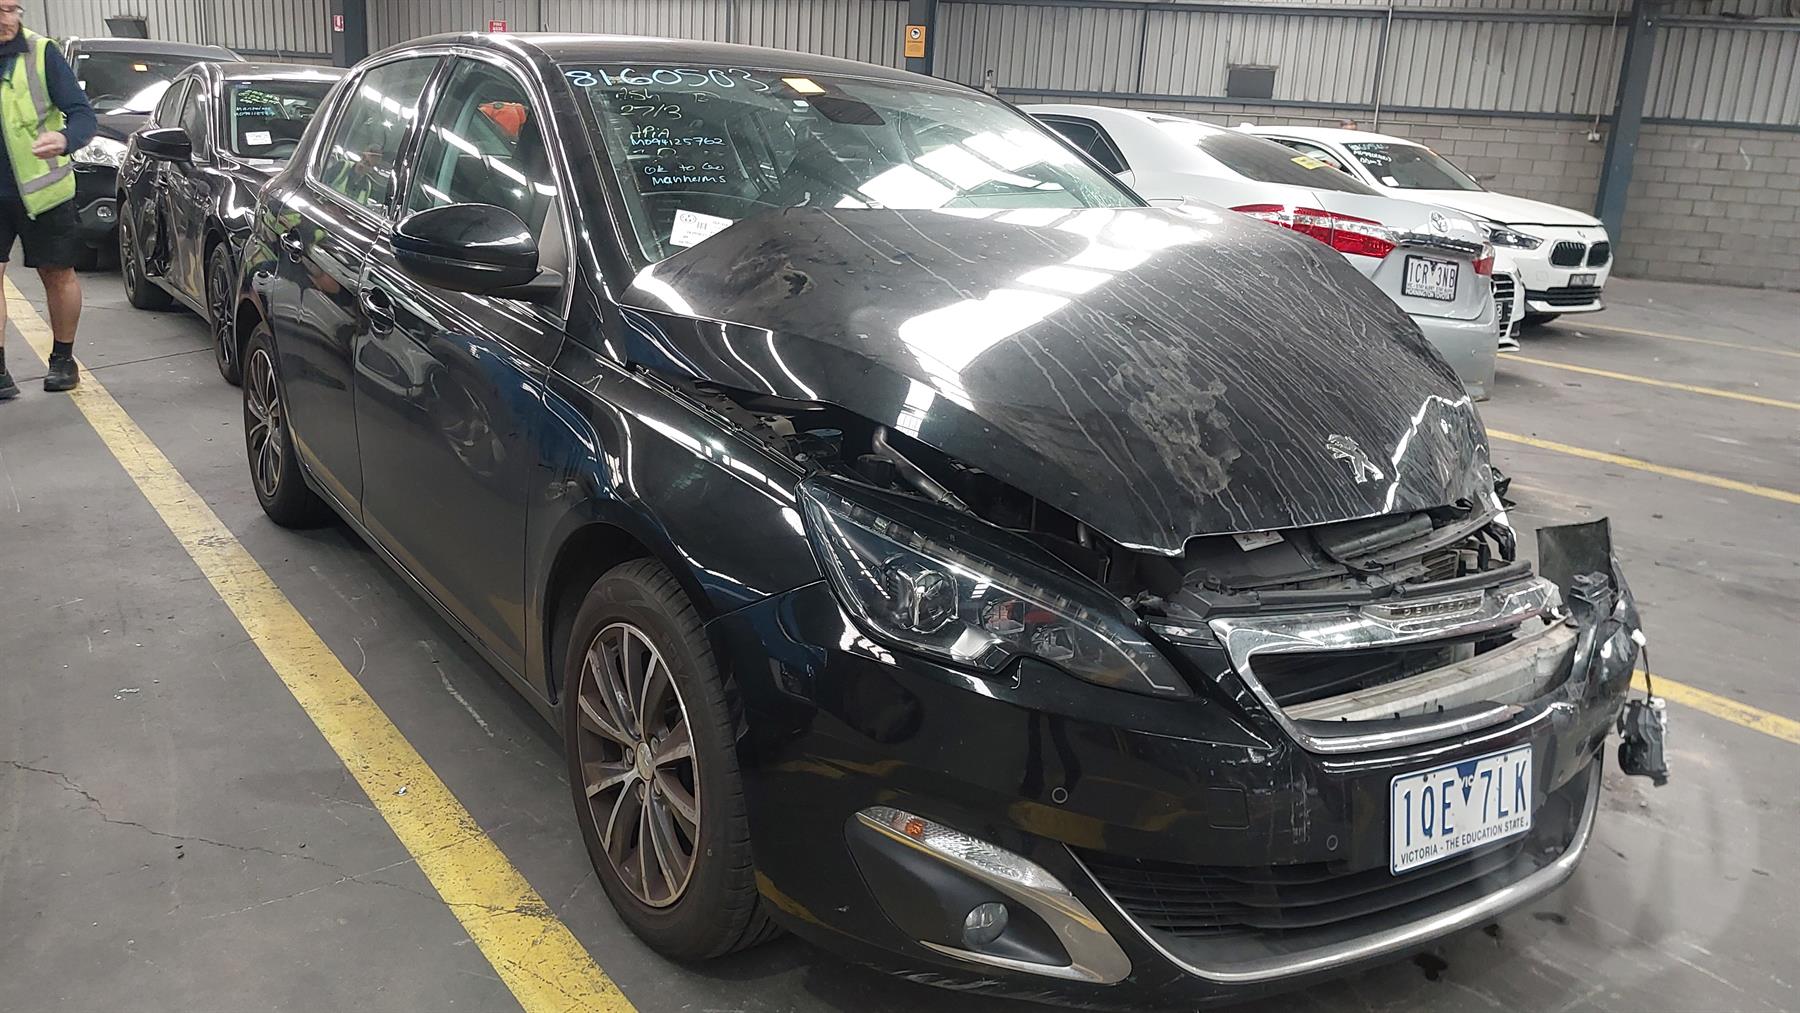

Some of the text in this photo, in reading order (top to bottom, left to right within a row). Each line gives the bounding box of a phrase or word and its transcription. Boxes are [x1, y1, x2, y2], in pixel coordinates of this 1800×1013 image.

[1436, 267, 1456, 288] 3NB
[1461, 774, 1474, 788] VIC
[1404, 760, 1527, 847] 1QE 7LK
[1400, 844, 1439, 865] VICTORIA
[1446, 834, 1460, 851] THE
[1462, 823, 1503, 846] EDUCATION
[1504, 816, 1525, 832] STATE
